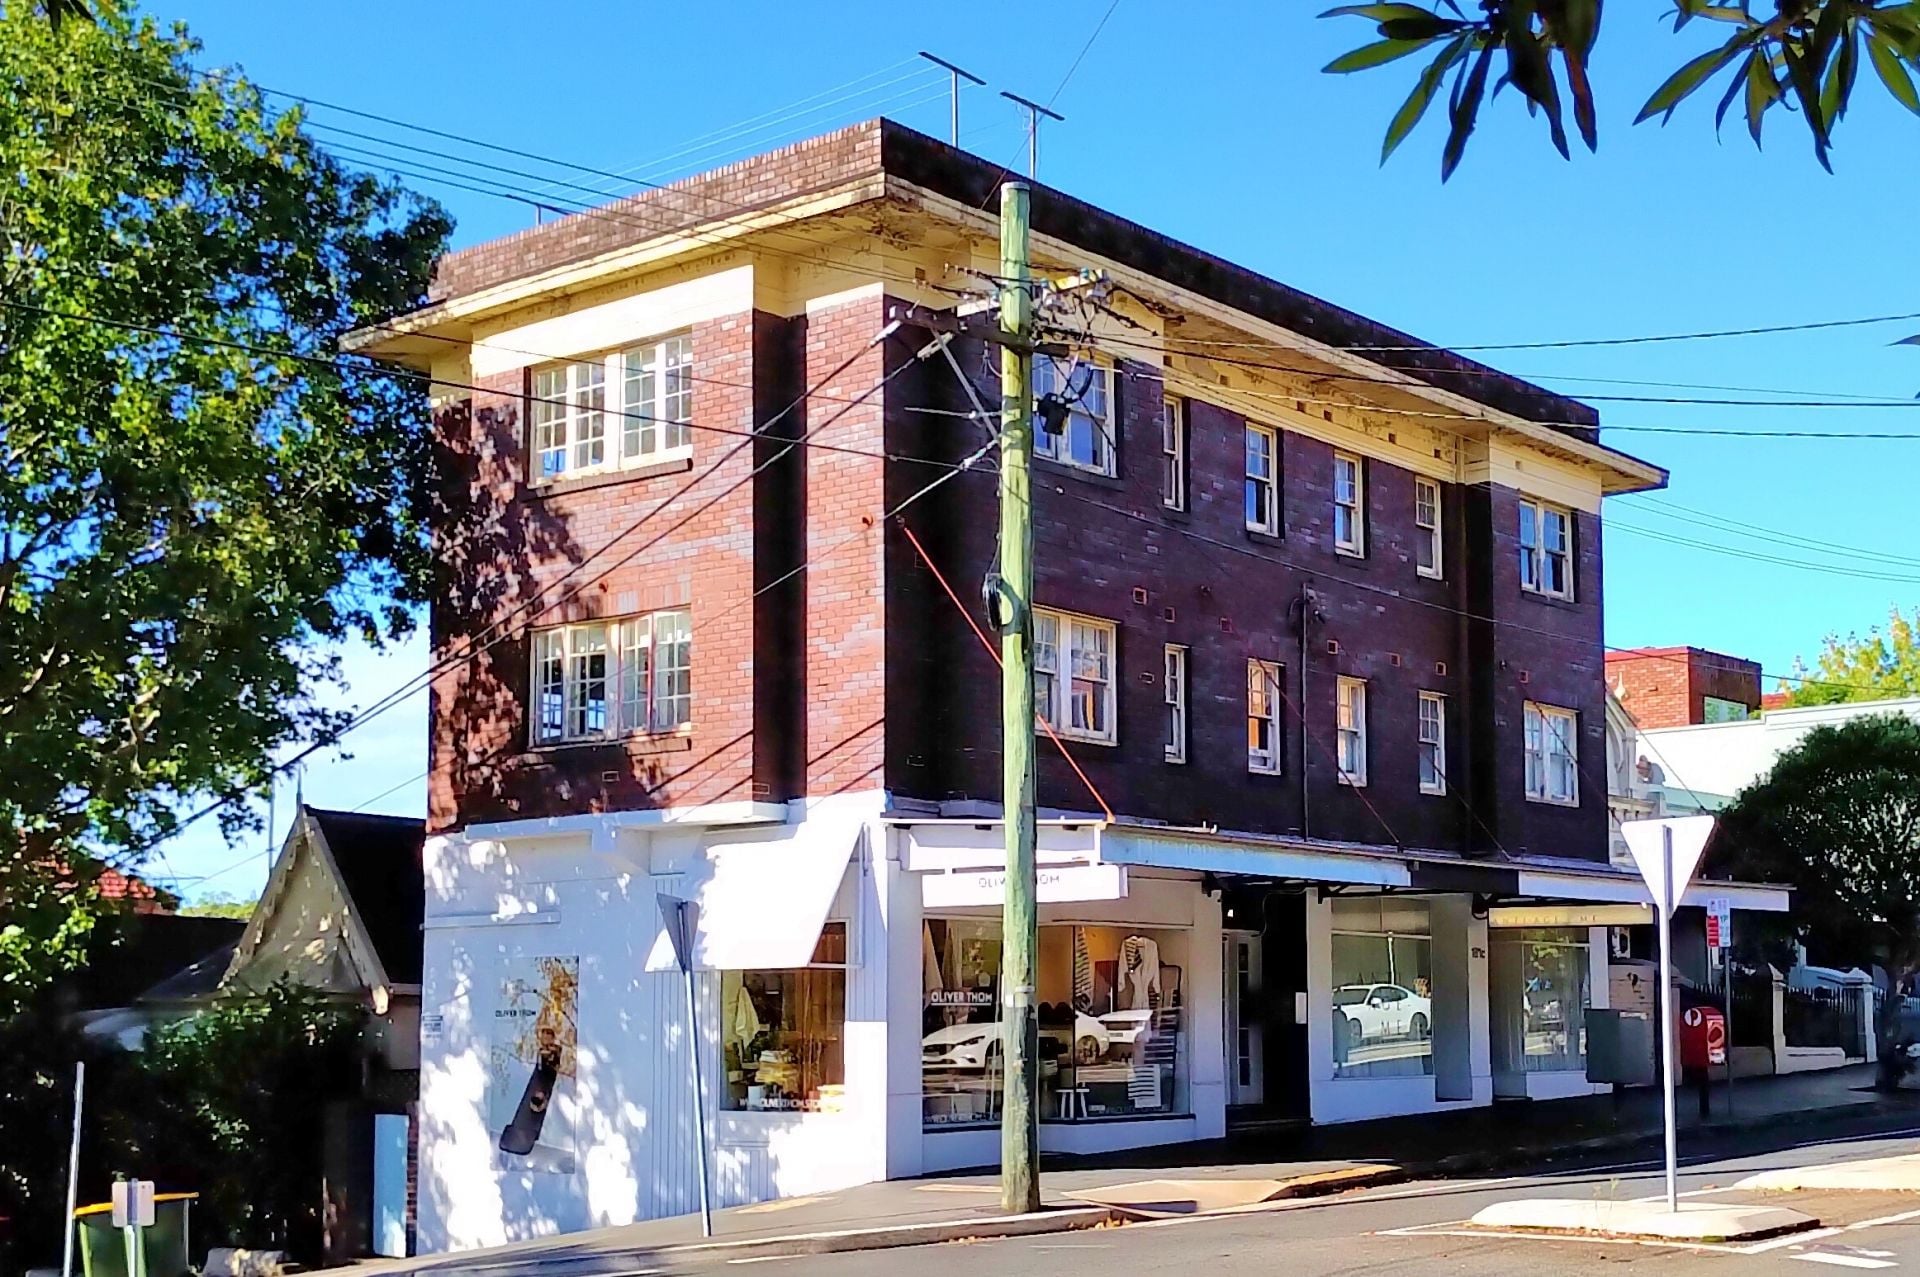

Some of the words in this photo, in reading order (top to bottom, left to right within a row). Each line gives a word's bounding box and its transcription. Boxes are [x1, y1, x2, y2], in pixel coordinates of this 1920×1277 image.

[979, 877, 1006, 888] OLIV
[931, 991, 965, 1003] OLIVER
[966, 991, 993, 1003] THOM
